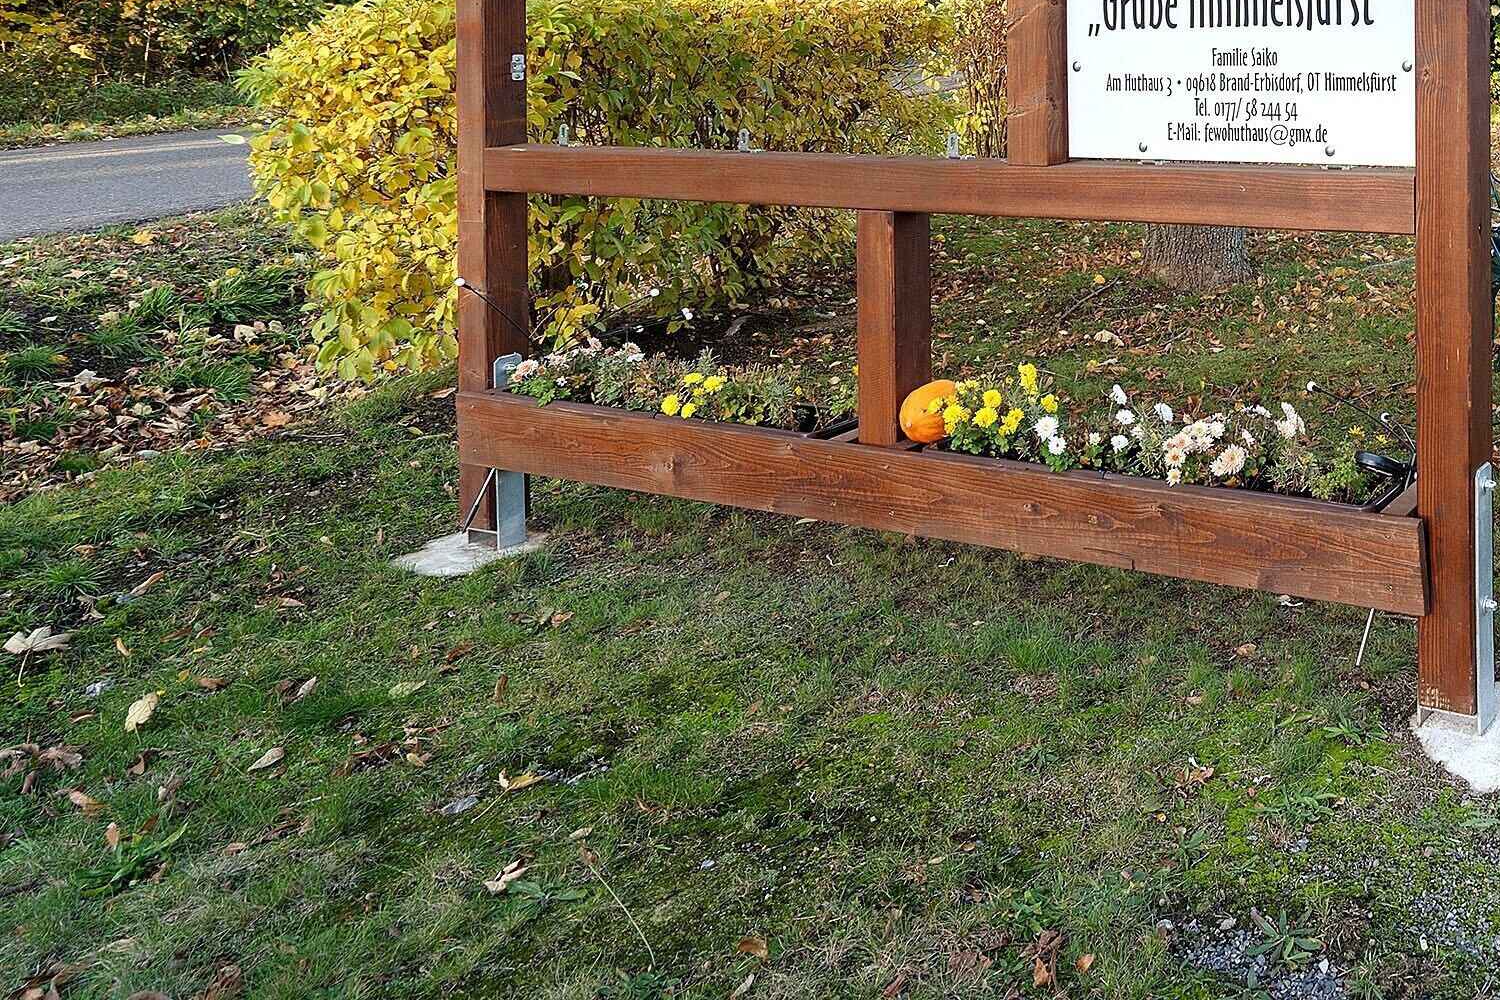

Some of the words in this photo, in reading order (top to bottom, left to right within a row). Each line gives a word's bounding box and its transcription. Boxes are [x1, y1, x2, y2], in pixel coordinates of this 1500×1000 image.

[1211, 47, 1248, 67] Familie
[1251, 47, 1278, 67] Saiko
[1106, 73, 1121, 92] Am
[1124, 73, 1163, 92] Huthaus
[1166, 77, 1172, 96] 3
[1186, 72, 1216, 96] 09618
[1219, 72, 1303, 94] Brand-Erbisdorf,
[1307, 72, 1321, 91] OT
[1324, 72, 1397, 93] Himmelsfürst
[1194, 97, 1211, 117] Tel.
[1214, 97, 1242, 121] 0177/
[1245, 97, 1258, 121] 58
[1260, 102, 1281, 121] 244
[1284, 102, 1298, 121] 54
[1167, 122, 1201, 141] E-Mail:
[1204, 122, 1328, 147] fewohuthaus@gmx.de
